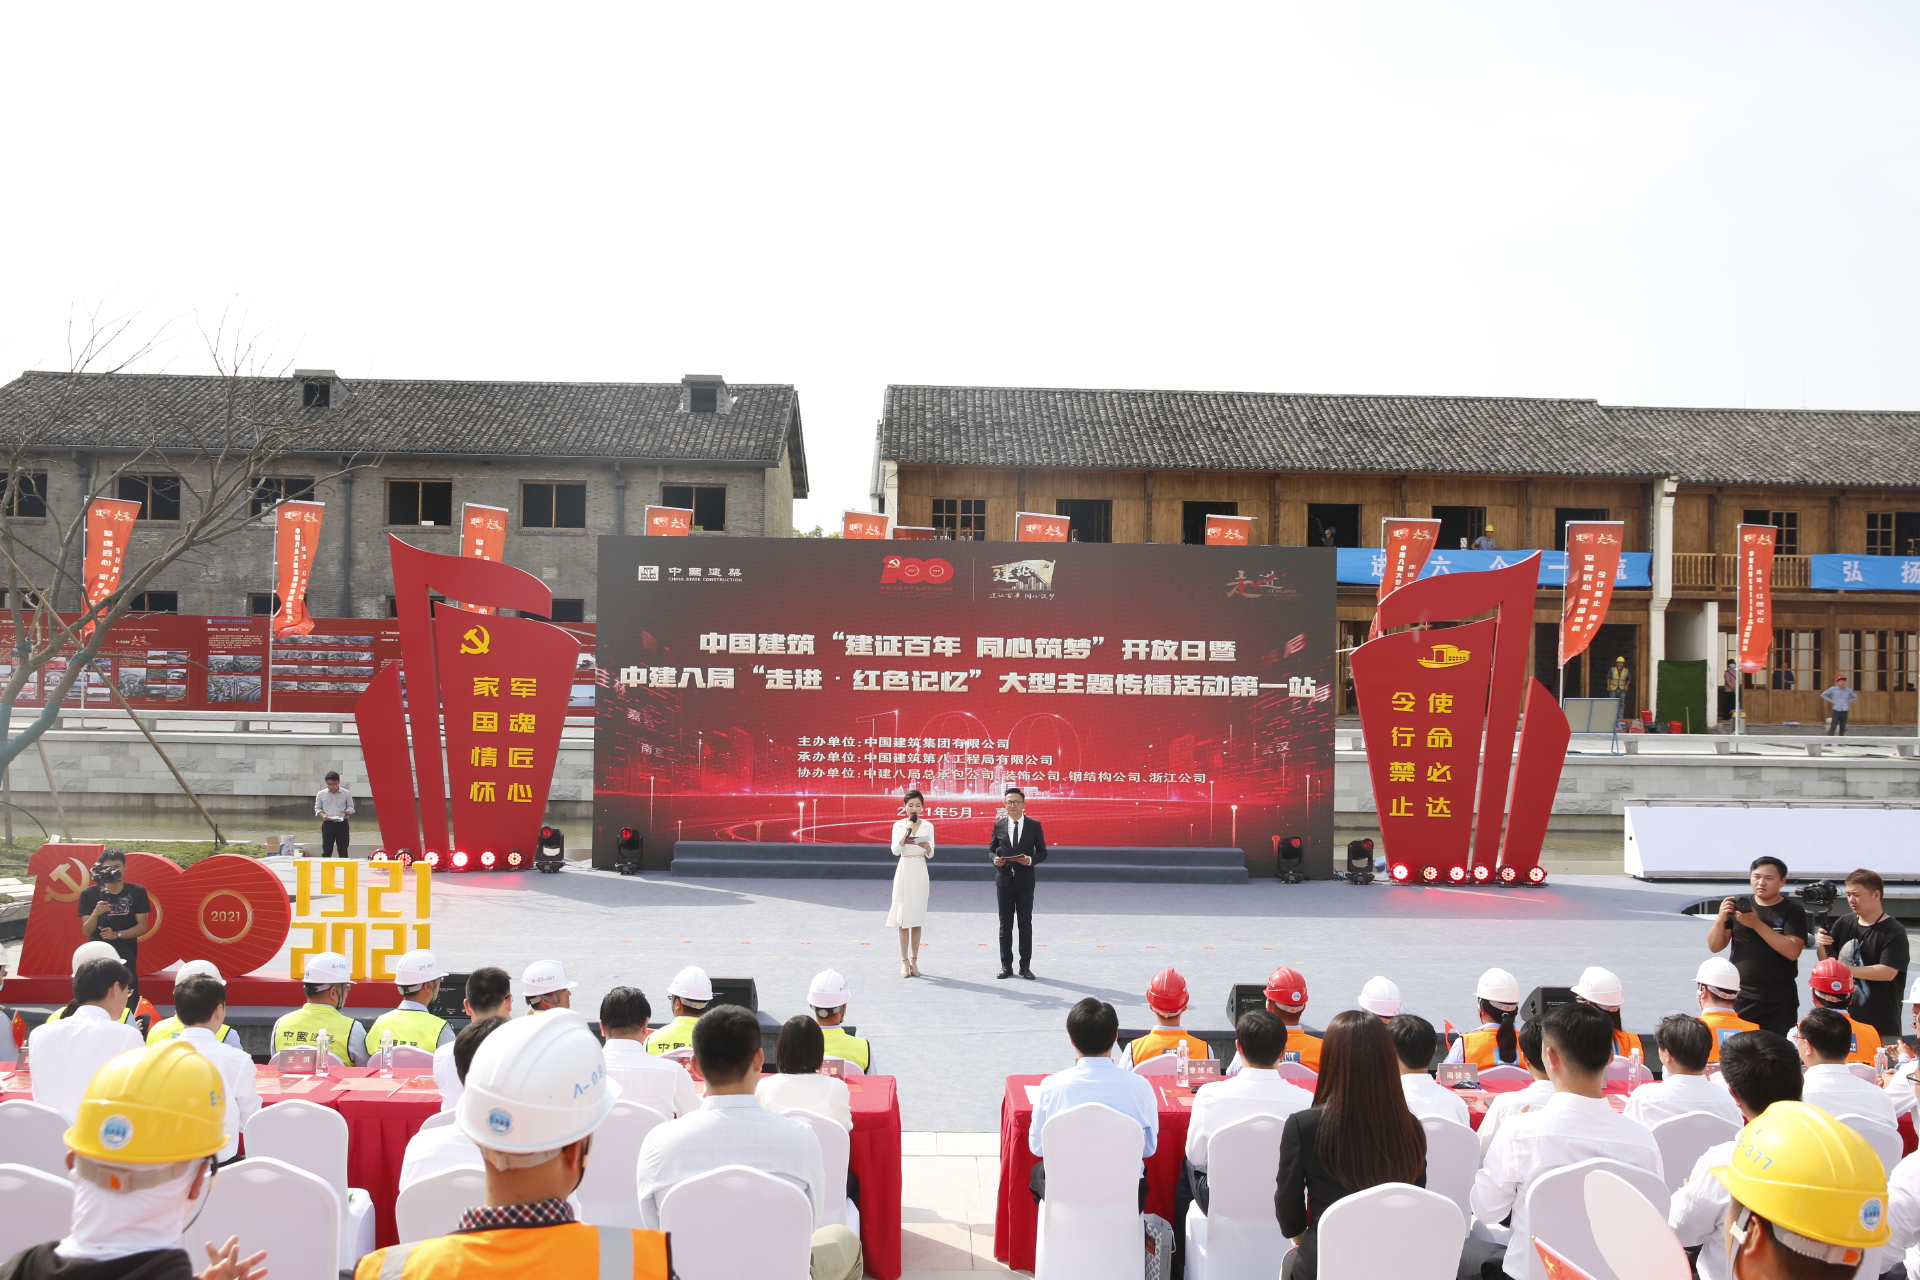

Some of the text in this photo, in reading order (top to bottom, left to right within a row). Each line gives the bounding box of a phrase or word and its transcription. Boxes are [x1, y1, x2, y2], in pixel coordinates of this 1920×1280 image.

[700, 632, 815, 655] 中国建筑
[1122, 639, 1237, 661] 开放日暨
[620, 665, 735, 689] 中建八局
[999, 672, 1317, 698] 大型主题传播活动第一站
[469, 676, 500, 803] 家国情怀
[507, 677, 537, 803] 军魂匠心
[1389, 691, 1416, 817] 令行禁止
[1426, 692, 1454, 818] 使命必达
[897, 806, 972, 819] 21年5月
[210, 910, 241, 922] 2021
[292, 859, 431, 919] 1921
